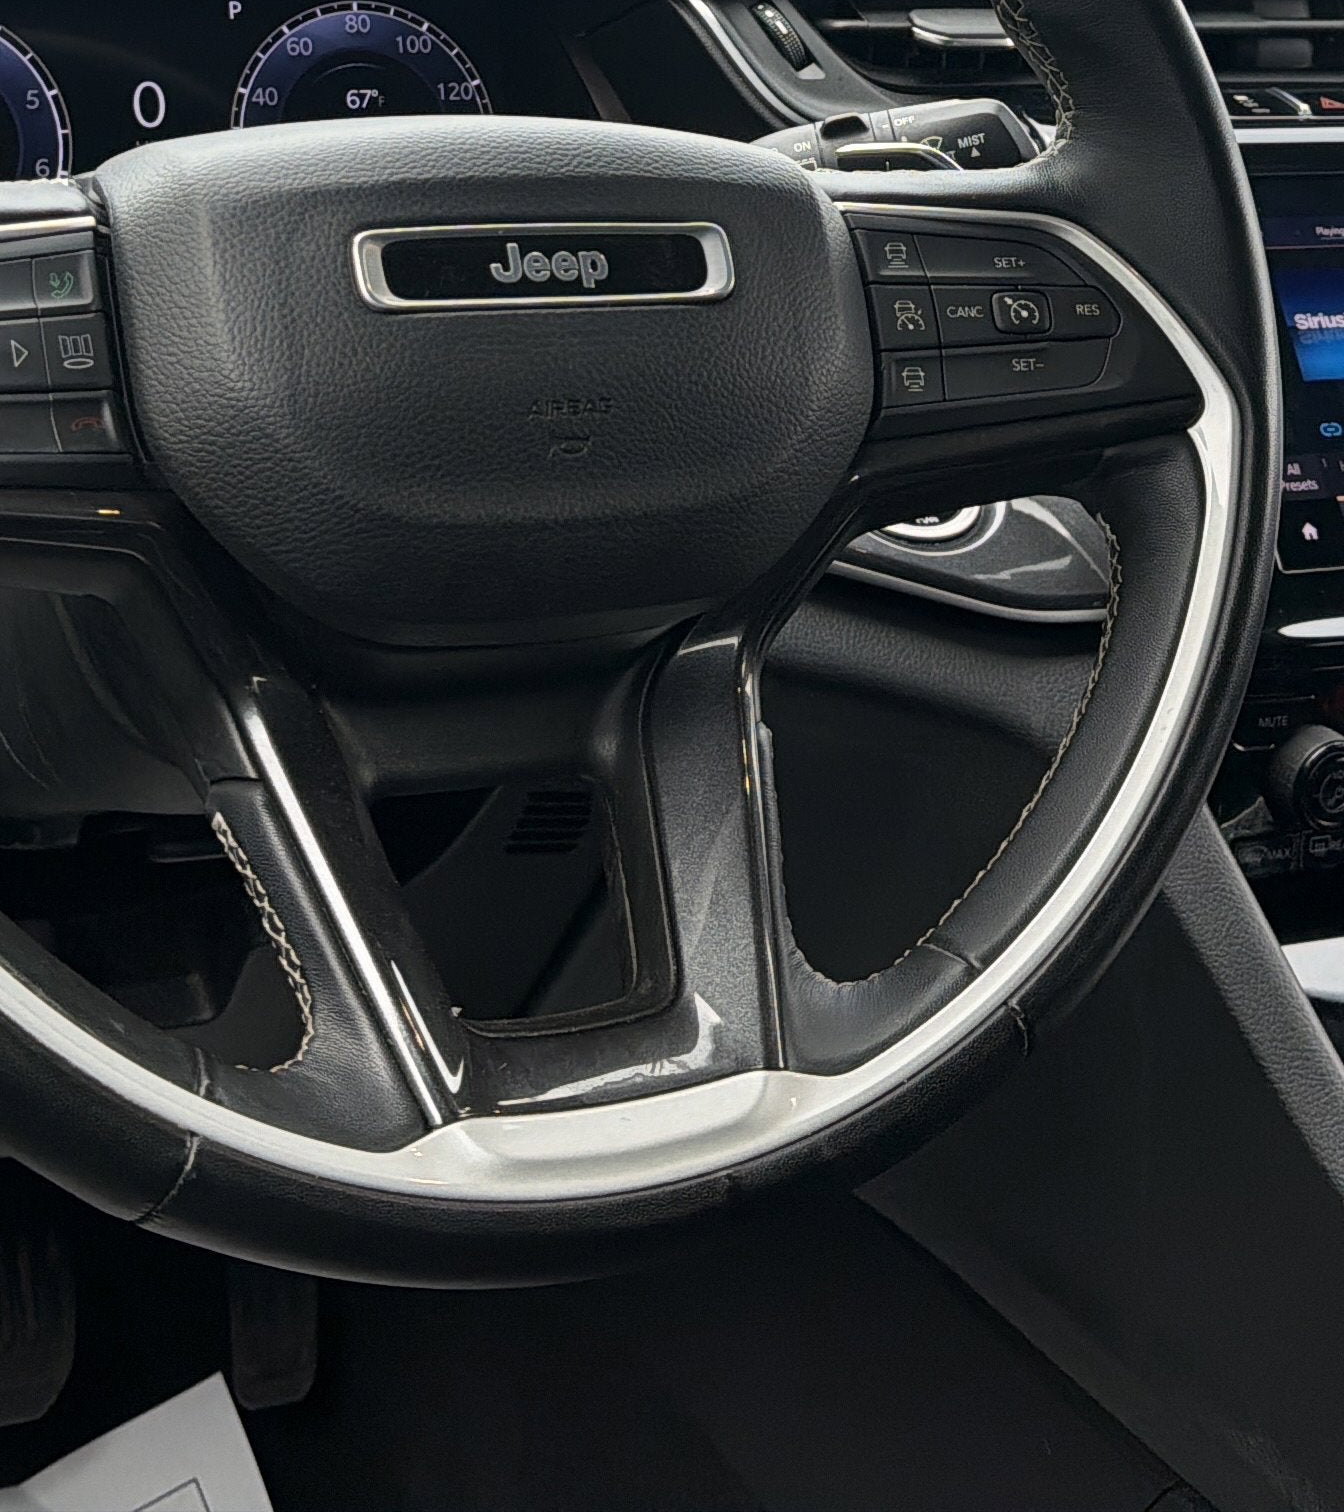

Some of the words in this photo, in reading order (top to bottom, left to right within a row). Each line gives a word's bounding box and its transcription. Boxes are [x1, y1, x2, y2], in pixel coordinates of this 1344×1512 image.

[228, 1, 241, 20] P
[344, 14, 371, 33] 80
[287, 37, 313, 56] 60
[395, 35, 432, 54] 100
[26, 90, 39, 109] 5
[252, 87, 278, 106] 40
[437, 82, 472, 101] 120
[133, 82, 166, 128] 0
[894, 115, 915, 126] OFF
[794, 141, 811, 152] ON
[958, 133, 986, 149] MIST
[35, 158, 50, 177] 6
[490, 242, 609, 288] Jeep
[993, 255, 1027, 270] SET+
[946, 304, 984, 319] CANC
[1075, 303, 1101, 317] RES
[1287, 463, 1301, 476] All
[1258, 715, 1288, 728] MUTE
